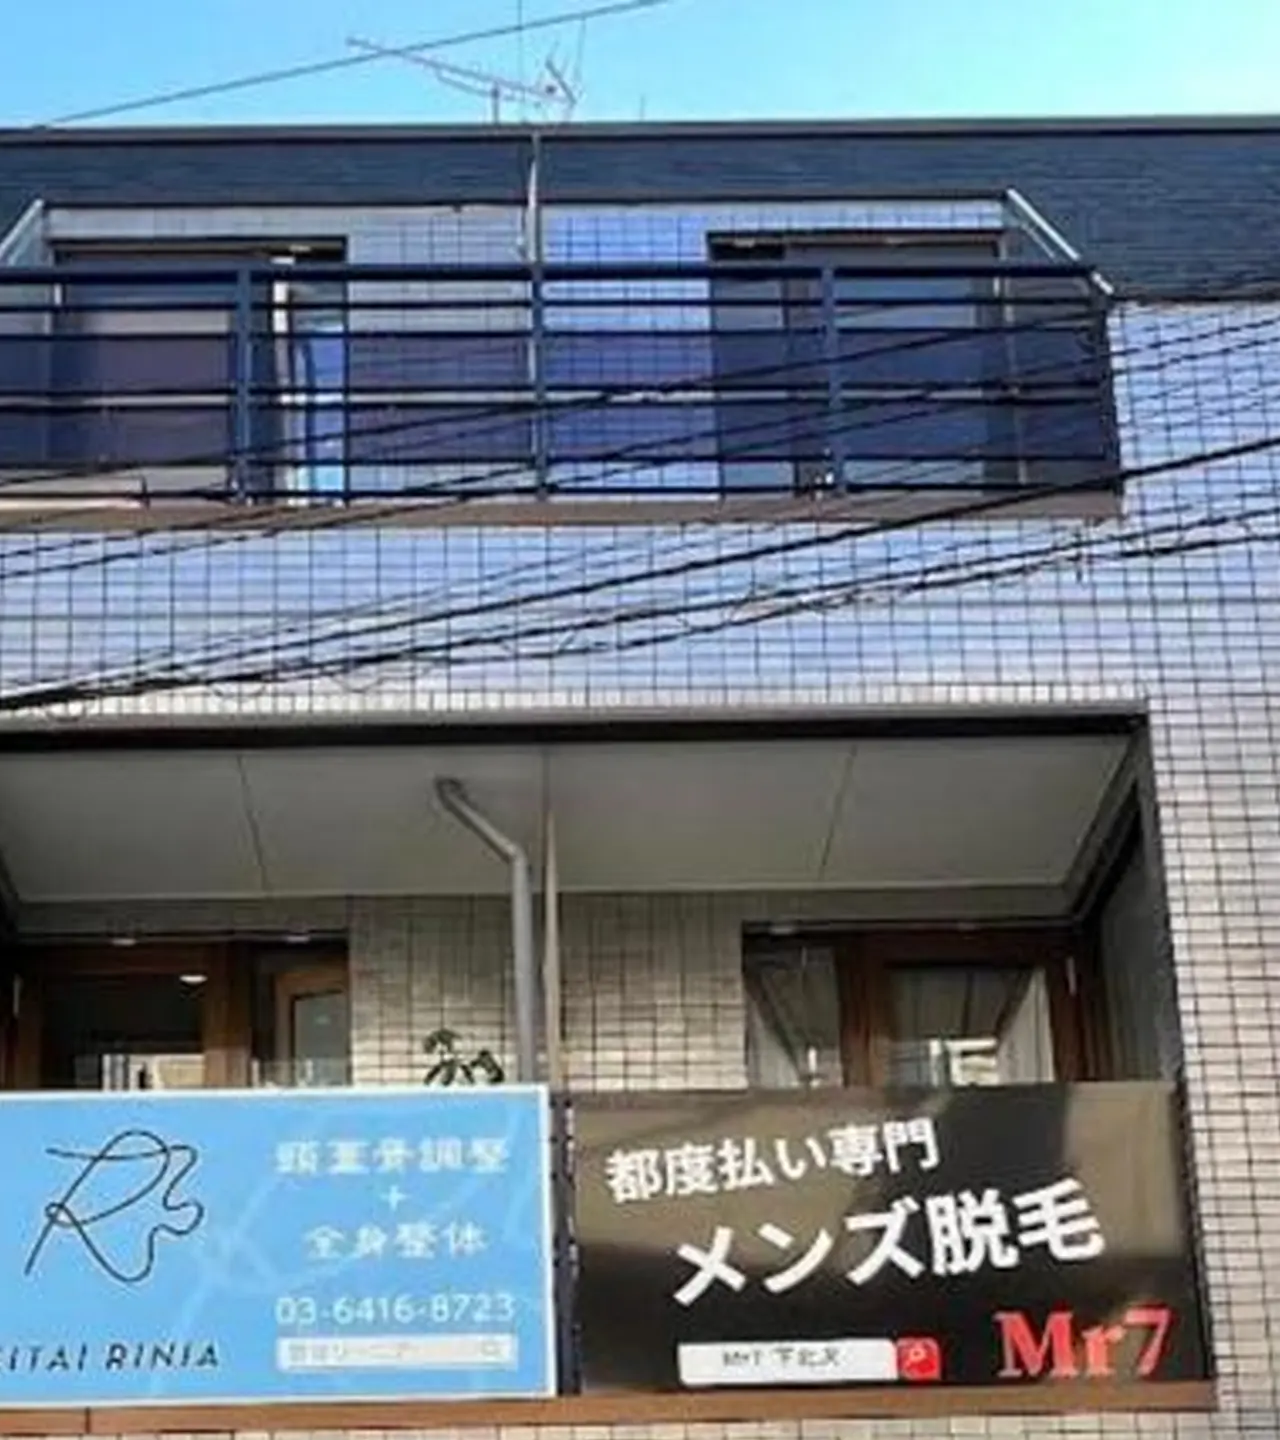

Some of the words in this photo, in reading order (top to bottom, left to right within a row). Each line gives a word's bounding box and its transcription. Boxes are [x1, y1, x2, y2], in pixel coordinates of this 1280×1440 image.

[605, 1117, 940, 1204] 都度払い専門
[304, 1221, 489, 1260] 全身整体
[673, 1178, 1106, 1306] メンズ脱毛
[275, 1293, 517, 1325] 03-6416-8723
[106, 1342, 220, 1370] RINIA
[993, 1301, 1173, 1380] Mr7
